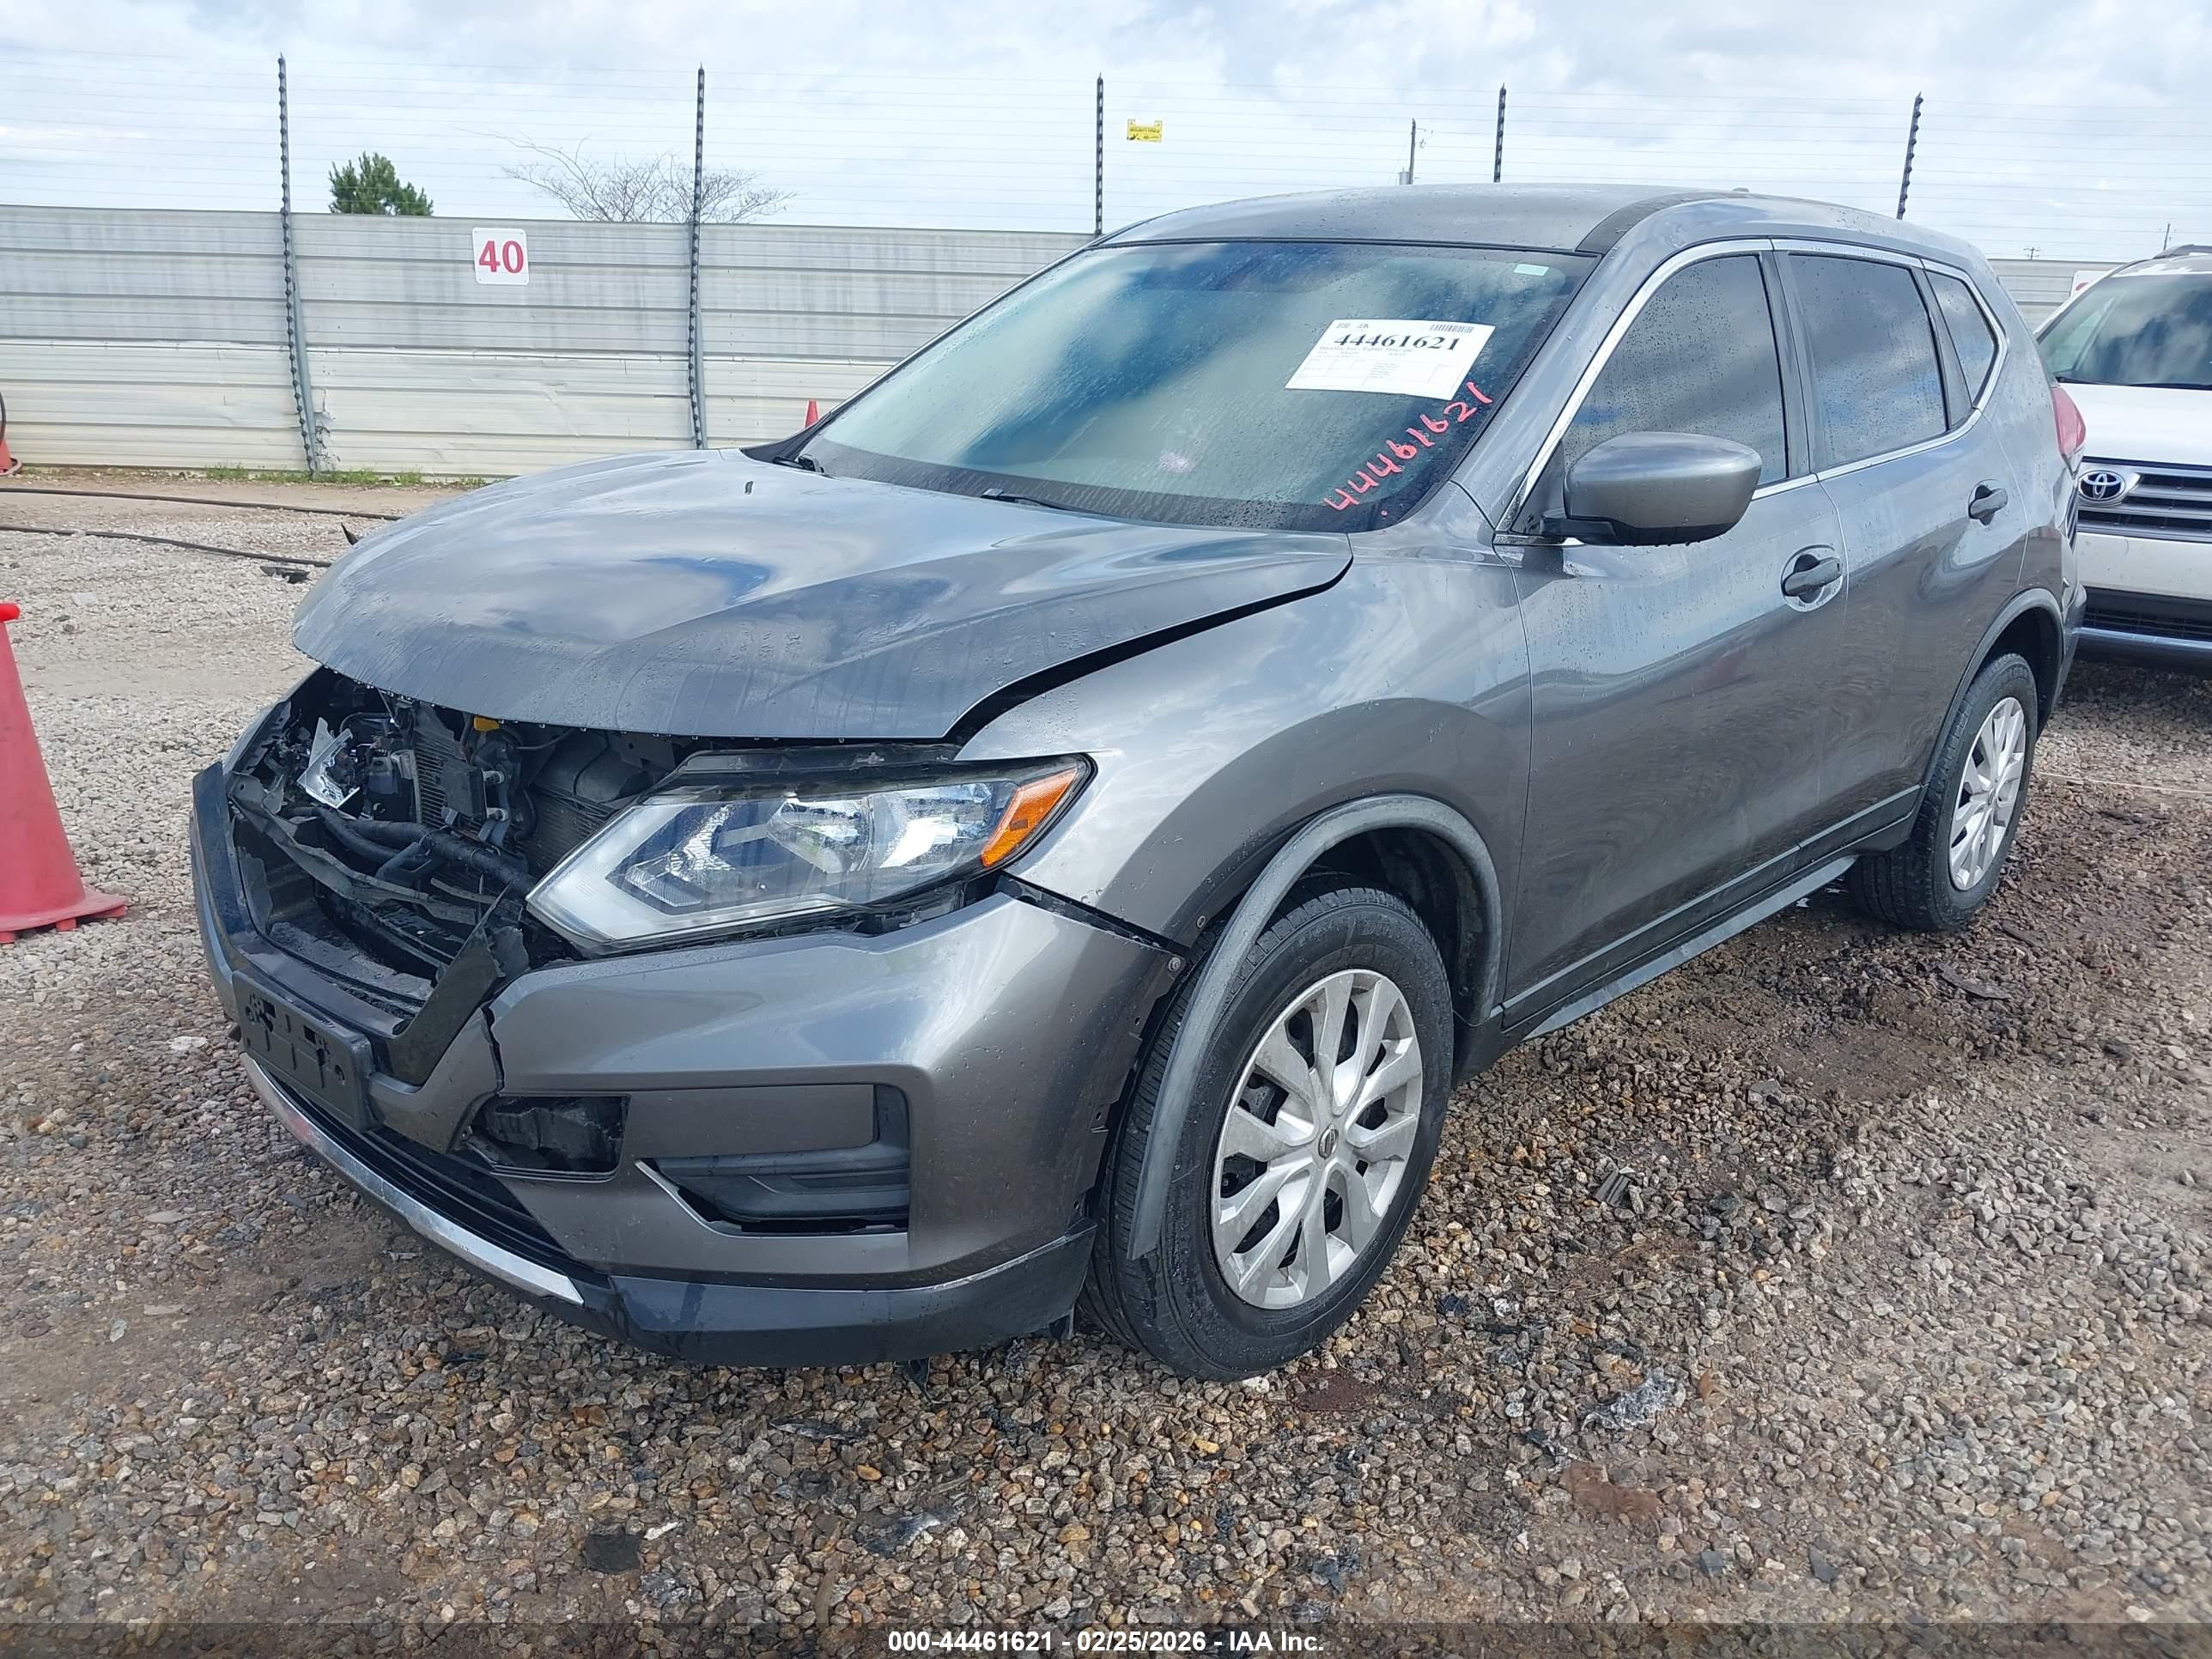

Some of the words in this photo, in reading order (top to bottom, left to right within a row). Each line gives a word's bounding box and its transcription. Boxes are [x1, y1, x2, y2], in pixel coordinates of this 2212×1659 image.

[478, 240, 525, 273] 40
[1334, 333, 1461, 350] 44461621
[1322, 381, 1493, 511] 44461621
